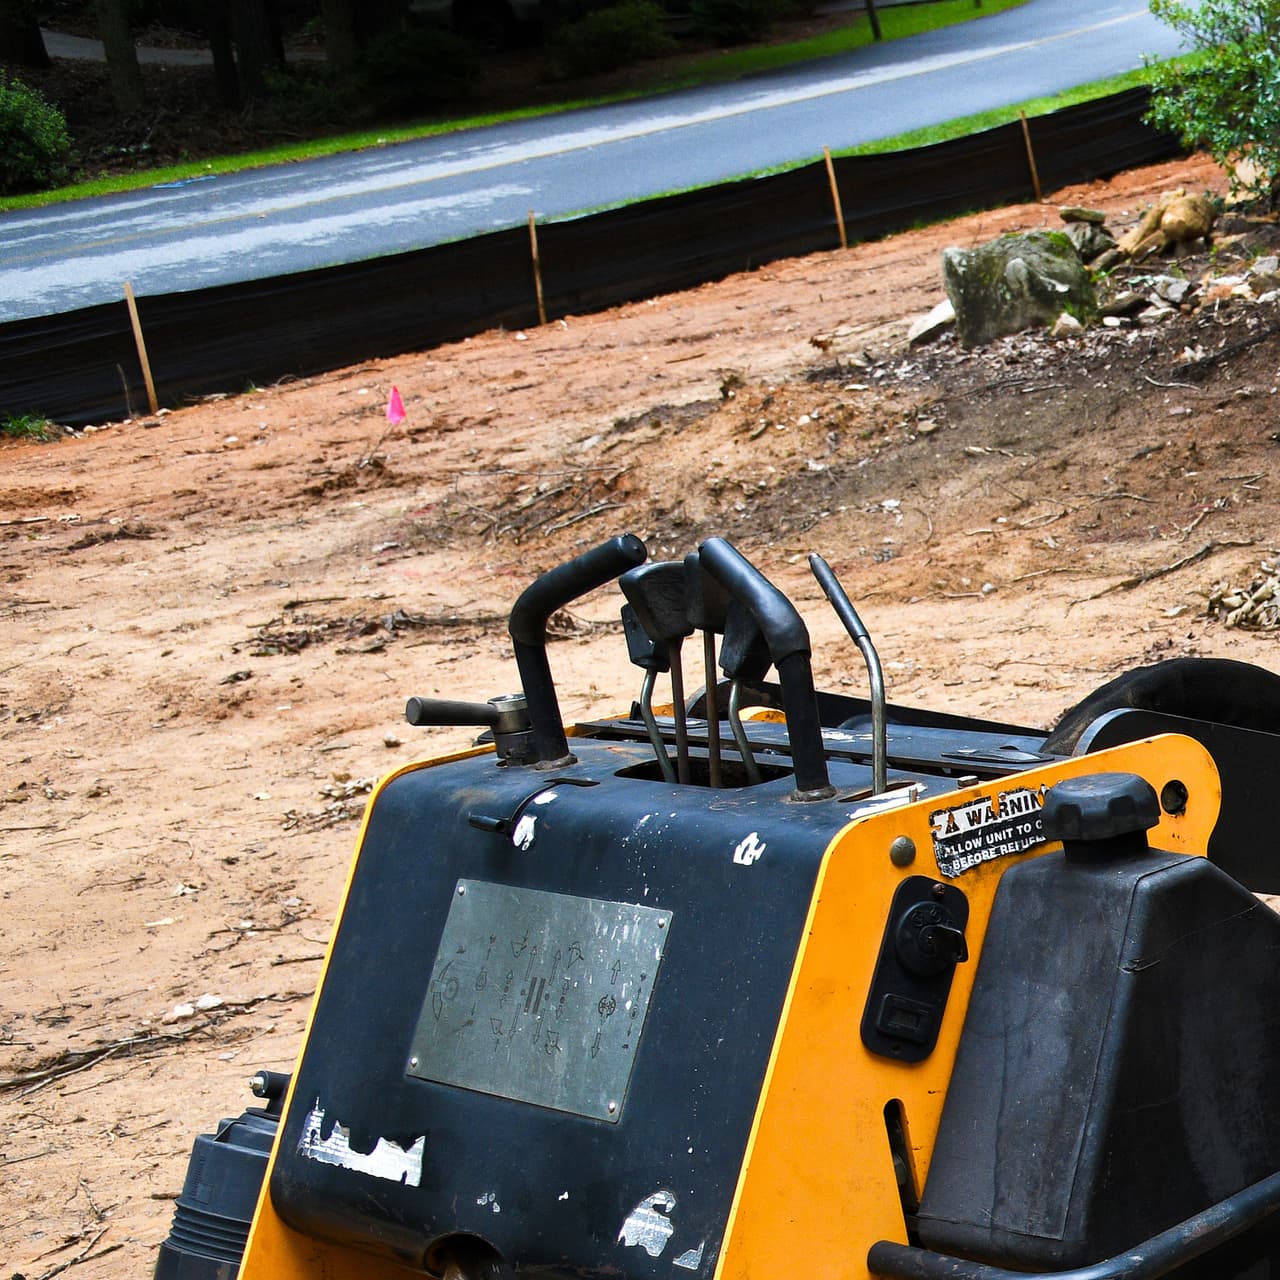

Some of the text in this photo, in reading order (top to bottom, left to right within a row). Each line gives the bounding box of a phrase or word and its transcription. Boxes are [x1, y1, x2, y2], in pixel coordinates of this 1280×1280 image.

[965, 792, 1042, 828] WARNIN
[985, 828, 1014, 845] UNIT
[1016, 822, 1032, 835] TO
[952, 846, 1000, 870] BEFORE
